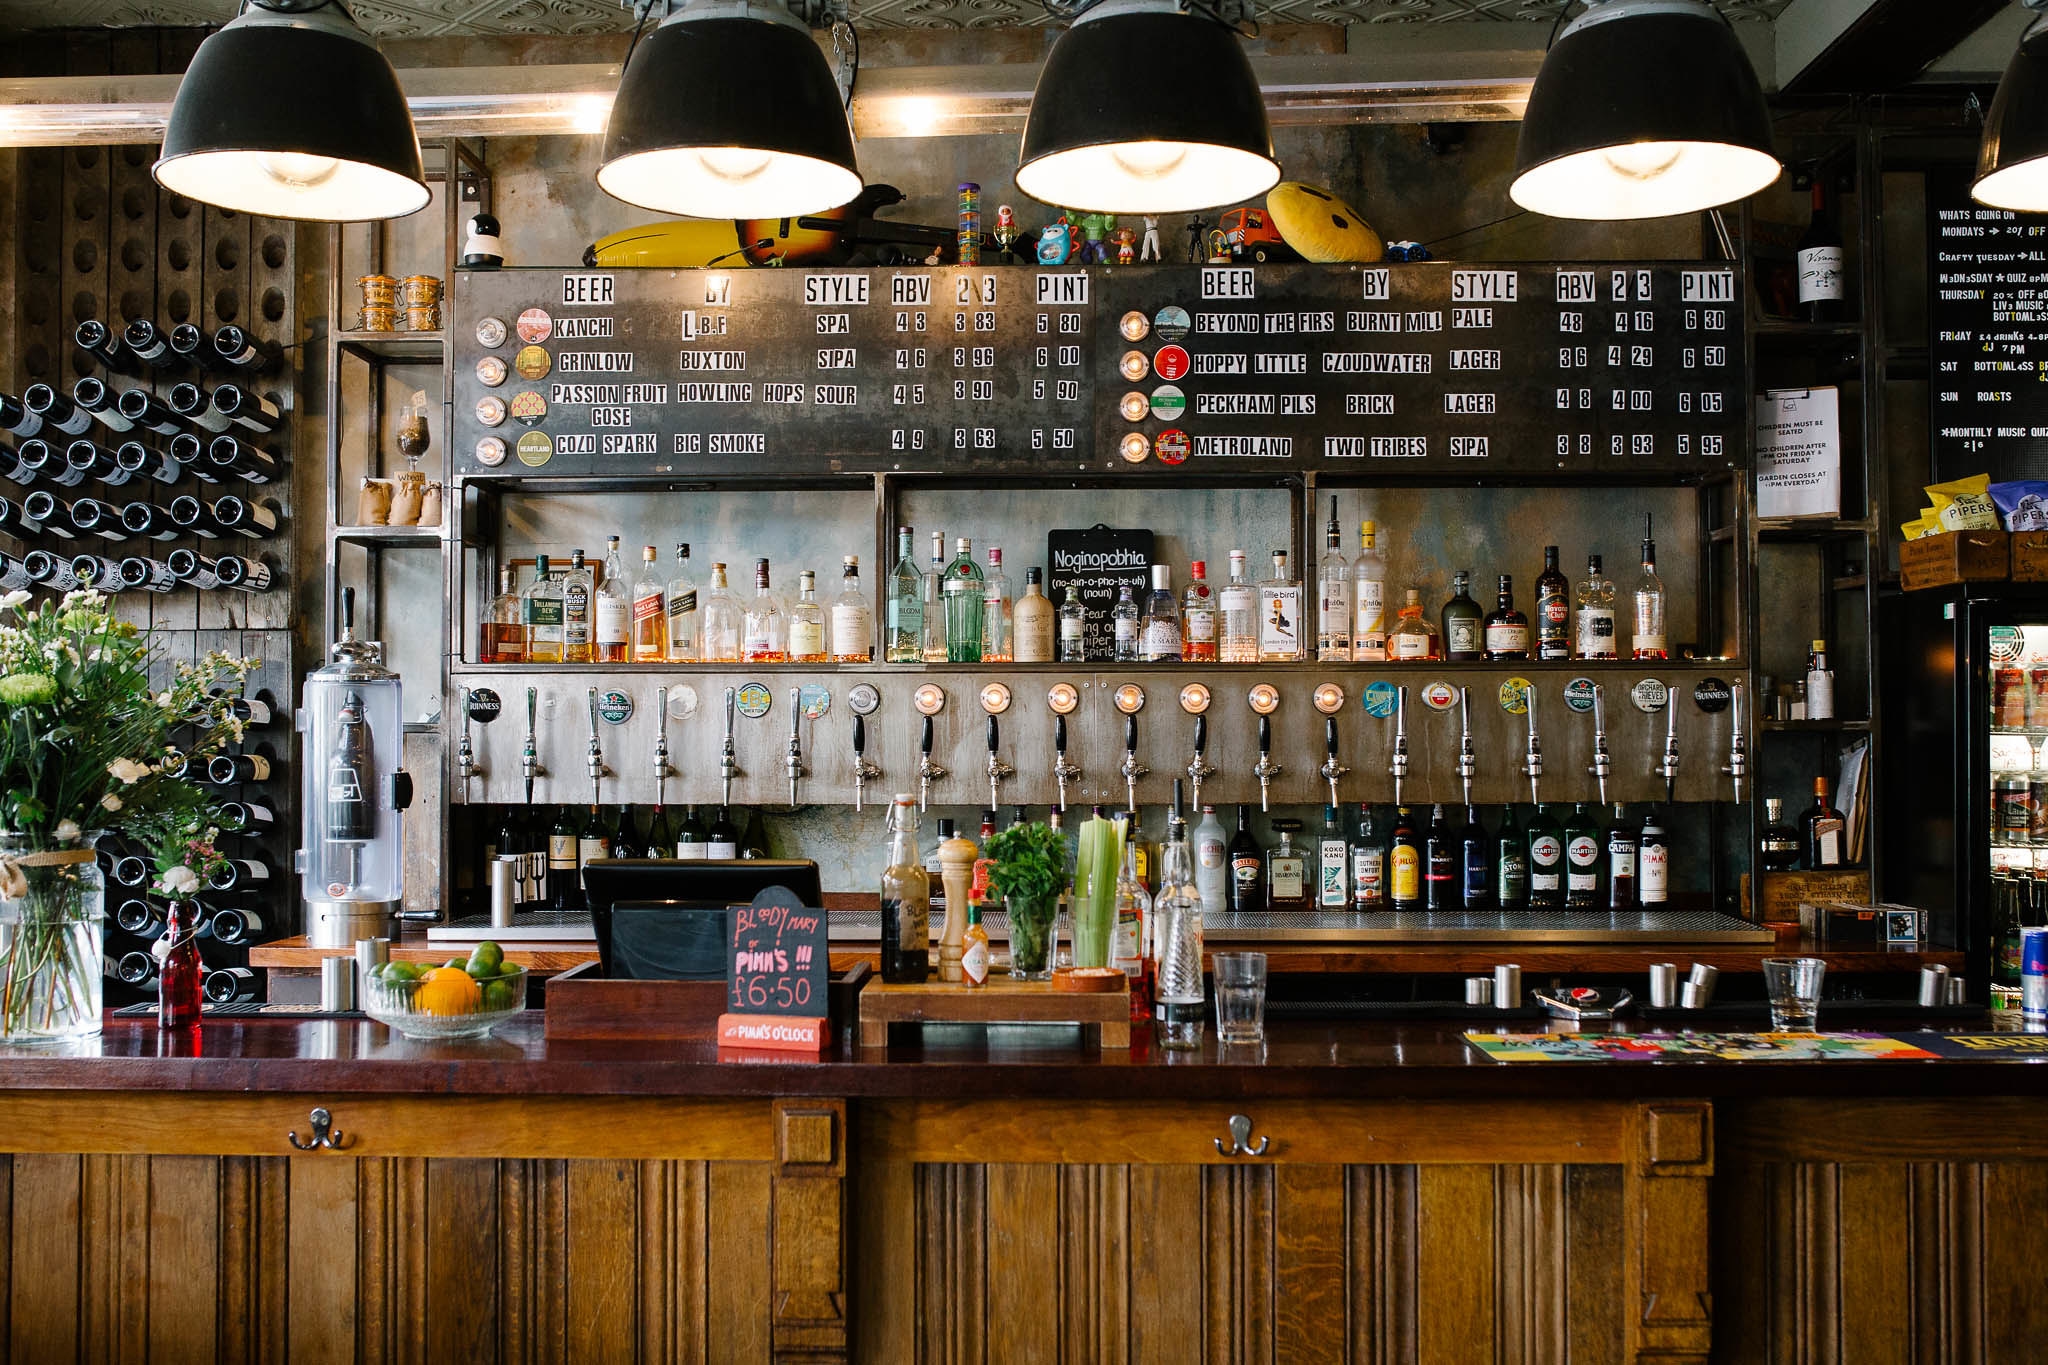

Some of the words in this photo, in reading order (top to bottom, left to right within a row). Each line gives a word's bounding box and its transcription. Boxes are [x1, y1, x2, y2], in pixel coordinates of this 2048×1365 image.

[1939, 210, 1970, 220] WHATS
[1942, 226, 1985, 237] MONDAYS
[2028, 226, 2046, 236] OFF
[2028, 251, 2046, 261] ALL
[2007, 273, 2027, 283] QUIZ
[564, 277, 613, 302] BEER
[806, 277, 867, 302] STYLE
[893, 278, 929, 303] ABV
[1038, 276, 1087, 302] PINT
[1203, 271, 1253, 296] BEER
[1365, 271, 1388, 297] BY
[1454, 273, 1515, 299] STYLE
[1558, 274, 1594, 300] ABV
[1683, 274, 1732, 299] PINT
[1940, 289, 1985, 300] THURSDAY
[2018, 289, 2035, 299] OFF
[2015, 300, 2044, 310] MUSIC
[555, 318, 613, 337] KANCHI
[817, 315, 848, 332] SPA
[1197, 314, 1258, 333] BEYOND
[1265, 314, 1293, 332] THE
[1300, 313, 1333, 331] FIRS
[1348, 313, 1399, 331] BURNT
[1406, 312, 1441, 331] MILL
[1453, 309, 1491, 327] PALE
[2010, 344, 2025, 354] PM
[560, 353, 631, 372] GRINLOW
[681, 352, 744, 370] BUXTON
[819, 350, 854, 368] SIPA
[1195, 355, 1246, 373] HOPPY
[1256, 355, 1306, 373] LITTLE
[1451, 351, 1499, 369] LAGER
[1940, 361, 1958, 371] SAT
[553, 385, 618, 403] PASSION
[624, 385, 666, 403] FRUIT
[679, 384, 751, 402] HOWLING
[765, 384, 803, 402] HOPS
[817, 386, 855, 404] SOUR
[1940, 392, 1959, 402] SUN
[1977, 391, 2012, 402] ROASTS
[1198, 395, 1273, 413] PECKHAM
[1282, 395, 1315, 414] PILS
[1347, 395, 1393, 413] BRICK
[1445, 395, 1494, 413] LAGER
[593, 408, 630, 426] GOSE
[1758, 423, 1792, 431] CHILDREN
[1777, 428, 1803, 436] SEATED
[1997, 427, 2026, 437] MUSIC
[604, 435, 655, 452] SPARK
[675, 434, 699, 452] BIG
[710, 435, 763, 452] SMOKE
[1195, 437, 1291, 456] METROLAND
[1326, 437, 1363, 456] TWO
[1372, 438, 1425, 456] TRIBES
[1451, 438, 1487, 456] SIPA
[1770, 444, 1804, 452] CHILDREN
[1805, 442, 1827, 450] AFTER
[1790, 450, 1815, 458] FRIDAY
[1772, 457, 1811, 465] SATURDAY
[1759, 474, 1788, 482] GARDEN
[1790, 472, 1816, 480] CLOSES
[1784, 479, 1820, 487] EVERYDAY
[1949, 502, 1994, 519] PIPERS
[2012, 510, 2048, 525] PIPER
[1055, 548, 1147, 574] Noginopobhia
[1084, 588, 1113, 600] (noun)
[1280, 590, 1295, 599] bird
[1638, 683, 1664, 692] ORCHARD
[1695, 691, 1729, 701] GUINNESS
[786, 916, 819, 935] MARY
[738, 1023, 771, 1040] PIMM'S
[772, 1025, 814, 1042] O'CLOCK
